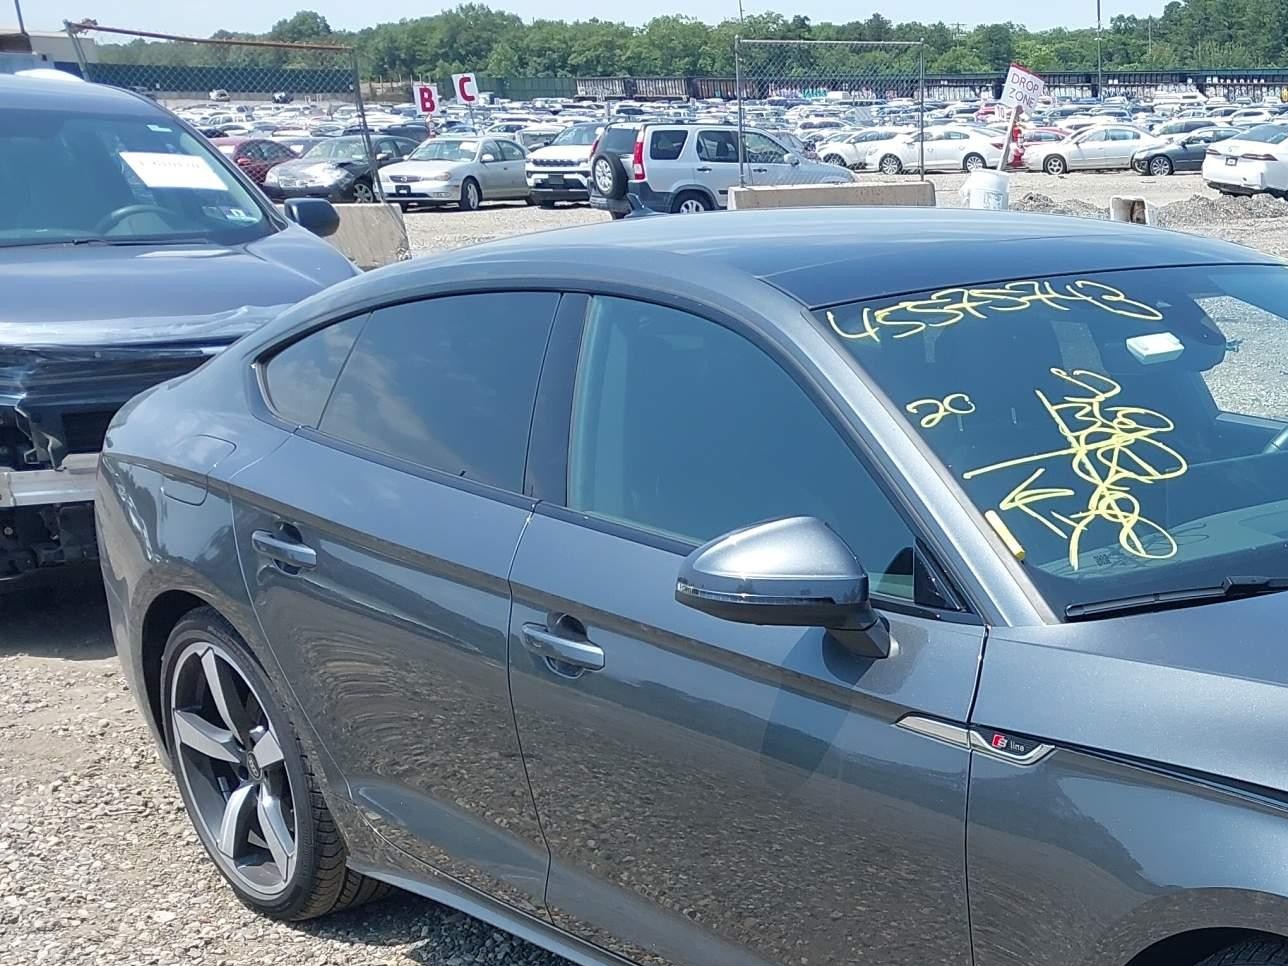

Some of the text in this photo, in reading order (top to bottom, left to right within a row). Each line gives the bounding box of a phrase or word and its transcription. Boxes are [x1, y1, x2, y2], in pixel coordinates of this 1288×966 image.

[459, 77, 475, 101] C
[1011, 73, 1039, 93] DROP
[419, 87, 435, 112] B
[1008, 87, 1036, 108] ZONE
[827, 280, 1163, 343] 45575743
[906, 393, 976, 428] 20
